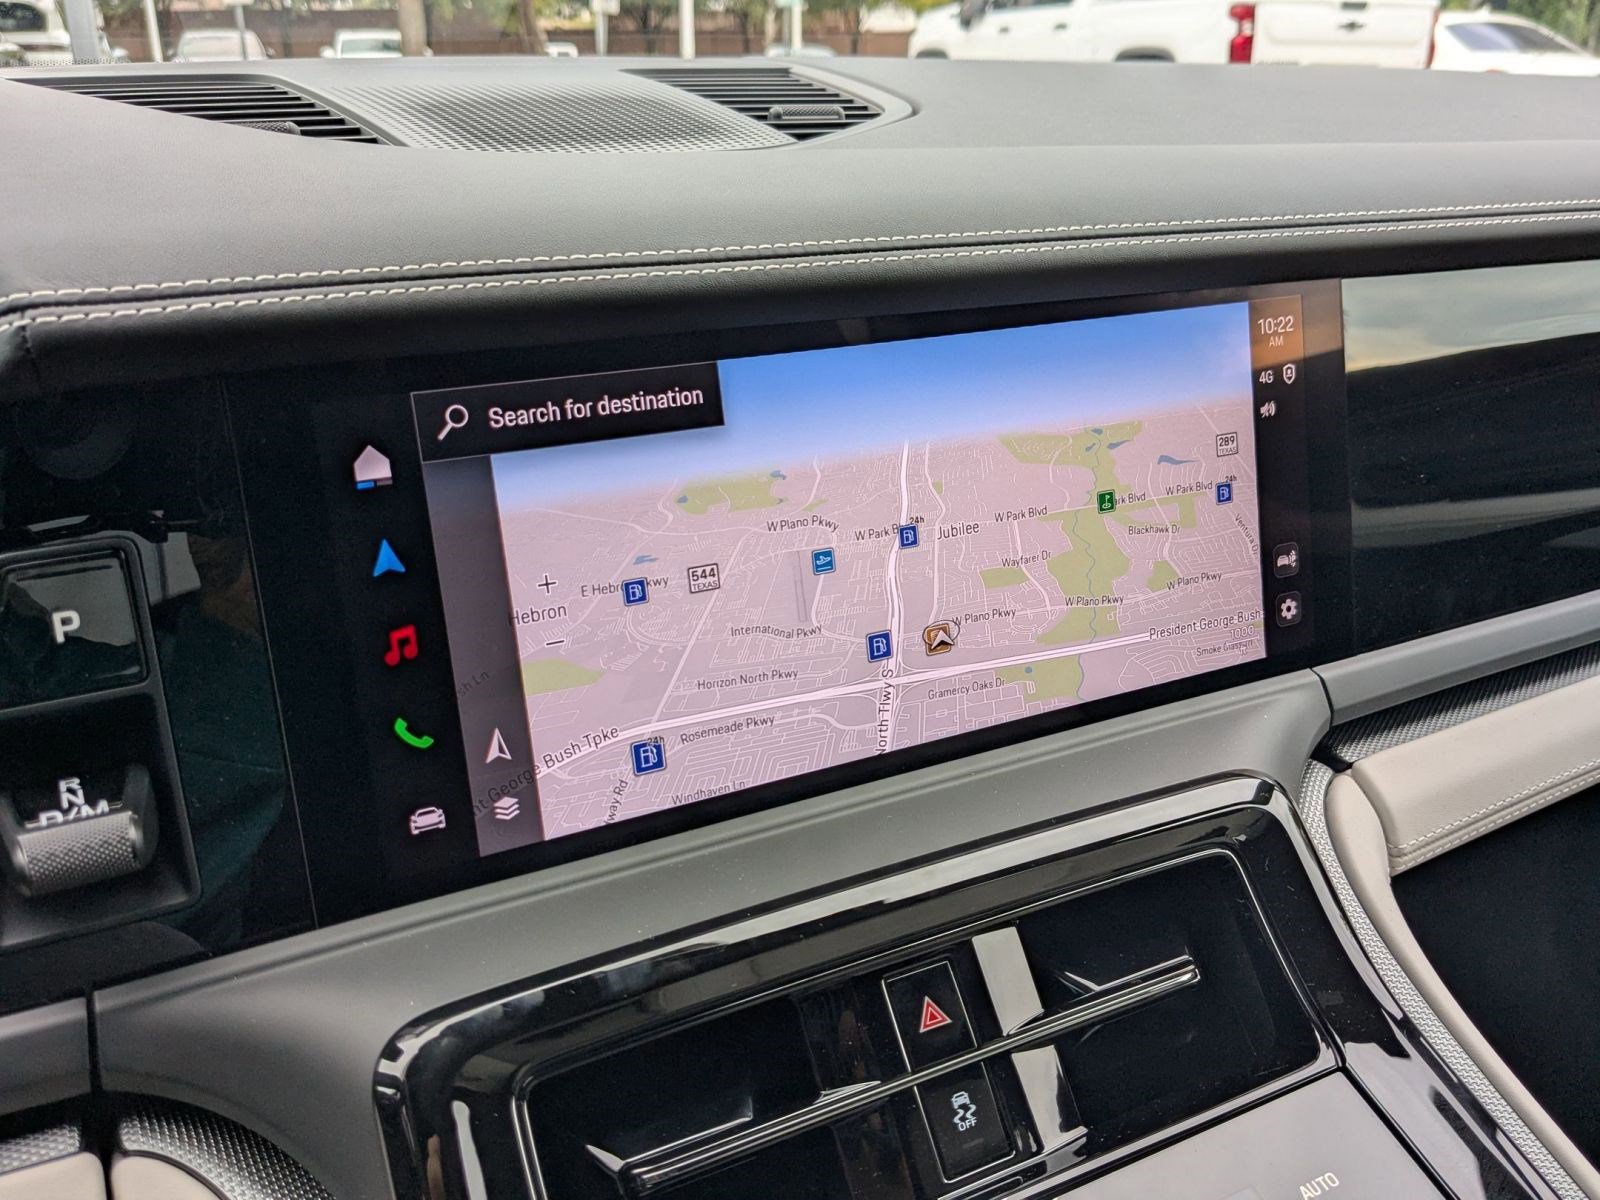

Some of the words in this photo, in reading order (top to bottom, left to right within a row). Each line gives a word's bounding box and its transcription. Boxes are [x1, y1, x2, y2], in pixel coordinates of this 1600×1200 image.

[1258, 315, 1295, 335] 10:22
[1269, 336, 1284, 348] AM
[1259, 370, 1274, 384] 4G
[488, 401, 560, 429] Search
[565, 398, 593, 422] for
[599, 387, 704, 417] destination
[1218, 435, 1235, 447] 289
[1218, 446, 1236, 455] TEXAS
[1165, 486, 1175, 496] W
[1176, 484, 1194, 494] Park
[1195, 480, 1213, 492] Blvd
[1114, 496, 1127, 506] ark
[1128, 492, 1146, 504] Blvd
[909, 516, 925, 525] 24h
[994, 511, 1004, 522] W
[1006, 509, 1026, 521] Park
[1027, 506, 1048, 519] Blvd
[767, 521, 776, 532] W
[776, 518, 809, 532] Plano
[811, 515, 840, 536] Pkwy
[855, 530, 866, 542] W
[868, 526, 890, 540] Park
[937, 522, 980, 540] Jubilee
[1128, 525, 1171, 536] Blackhawk
[1171, 524, 1181, 534] Dr
[1235, 513, 1254, 547] Ventura
[1001, 552, 1040, 570] Wayfarer
[1041, 550, 1052, 562] Dr
[691, 566, 717, 583] 544
[1166, 580, 1176, 592] W
[1177, 576, 1198, 590] Plano
[1199, 571, 1223, 587] Pkwy
[580, 585, 589, 598] E
[592, 581, 625, 597] Hebr
[647, 577, 670, 590] kwy
[692, 579, 719, 592] TEXAS
[1064, 596, 1075, 607] W
[1076, 595, 1100, 607] Plano
[1101, 594, 1124, 607] Pkwy
[508, 603, 568, 628] Hebron
[952, 616, 962, 626] W
[965, 612, 990, 624] Plano
[992, 607, 1017, 622] Pkwy
[1149, 621, 1197, 641] President
[1199, 615, 1235, 630] George
[1237, 608, 1261, 624] Bush
[52, 609, 81, 643] P
[730, 626, 795, 640] International
[796, 624, 823, 640] Pkwy
[1230, 625, 1255, 640] 1000
[1196, 645, 1221, 657] Smoke
[696, 675, 737, 691] Horizon
[739, 671, 769, 686] North
[771, 668, 799, 686] Pkwy
[928, 685, 970, 701] Gramercy
[972, 681, 993, 693] Oaks
[996, 678, 1006, 688] Dr
[875, 717, 889, 755] North
[882, 668, 894, 678] S
[680, 723, 744, 746] Rosemeade
[746, 714, 775, 734] Pkwy
[487, 763, 543, 803] George
[544, 740, 582, 768] Bush
[582, 726, 620, 751] Tpke
[58, 776, 82, 792] R
[613, 779, 629, 796] Rd
[671, 784, 730, 806] Windhaven
[732, 779, 746, 791] Ln
[60, 788, 85, 810] N
[604, 798, 623, 825] way
[958, 1117, 978, 1132] OFF
[1299, 1172, 1340, 1200] AUTO
